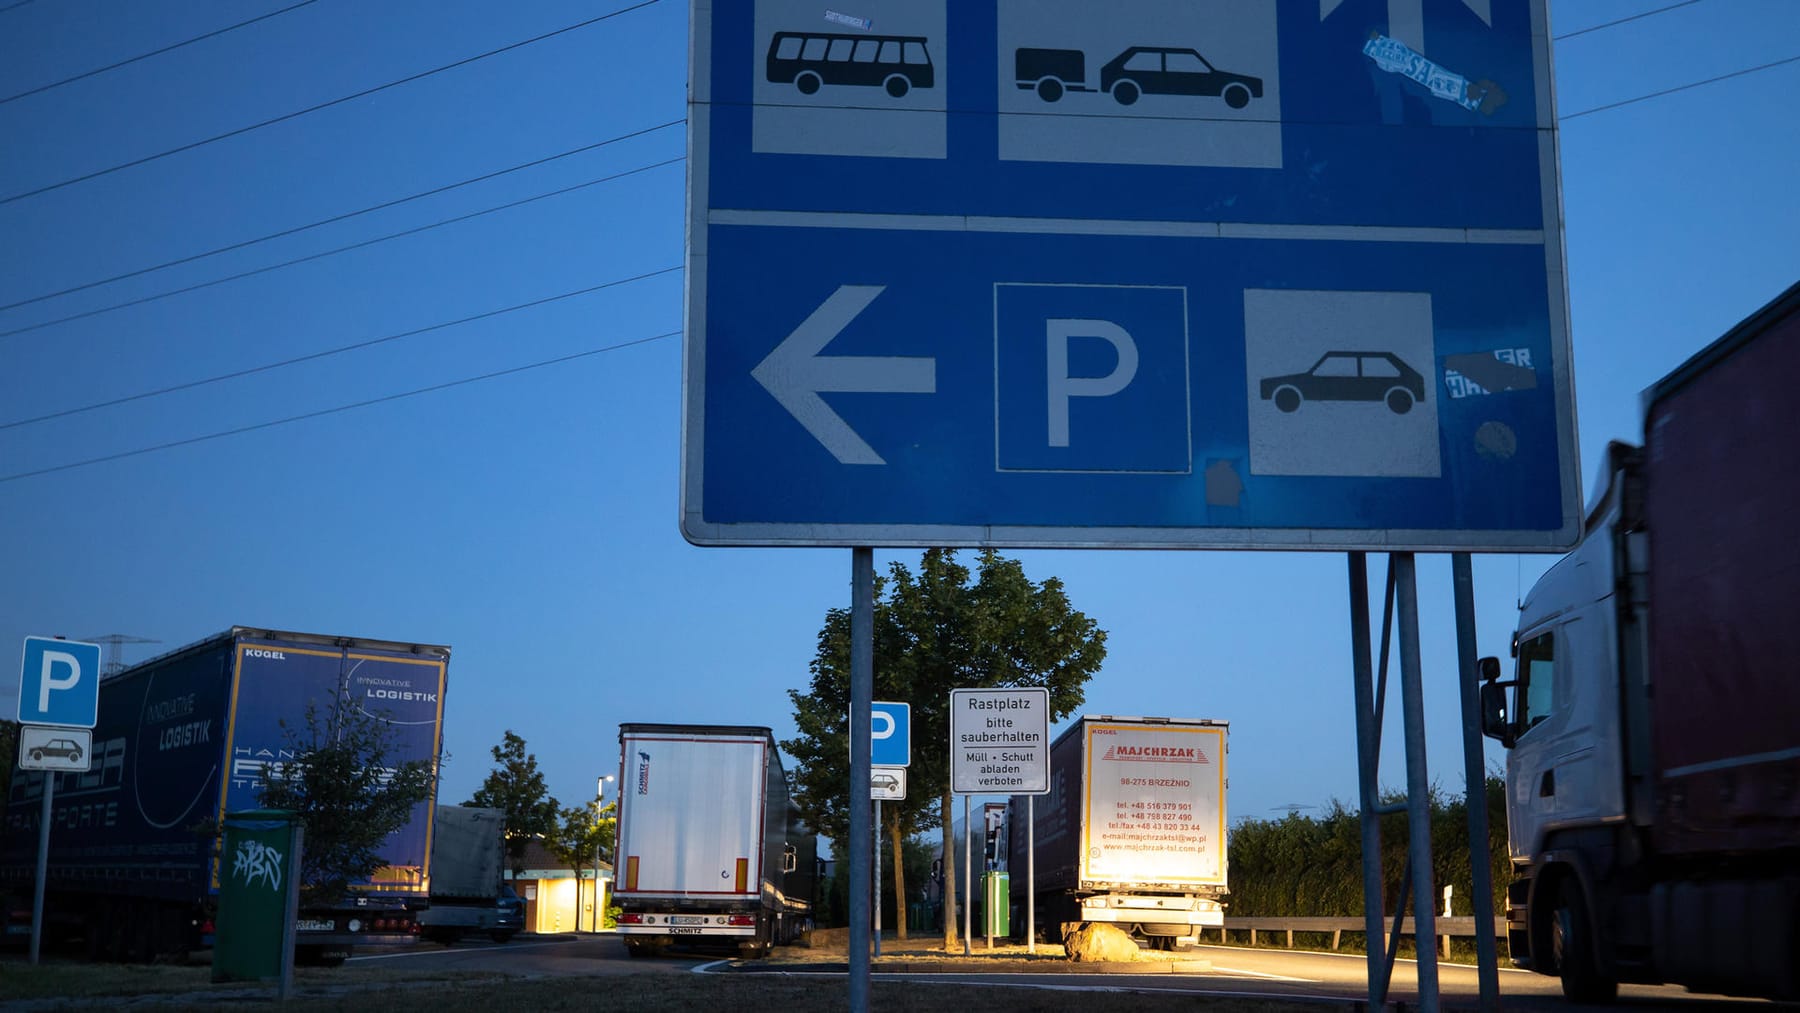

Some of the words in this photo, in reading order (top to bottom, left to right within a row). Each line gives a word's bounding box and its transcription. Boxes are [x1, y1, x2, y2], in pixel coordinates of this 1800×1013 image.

[1046, 318, 1139, 449] P
[37, 650, 82, 712] P
[367, 688, 438, 703] LOGISTIK
[968, 698, 1031, 711] Rastplatz
[986, 717, 1013, 728] bitte
[159, 719, 212, 752] LOGISTIK
[960, 731, 1040, 743] sauberhalten
[1117, 746, 1195, 757] MAJCHRZAK
[966, 752, 988, 763] Müll
[1001, 752, 1034, 763] Schutt
[980, 764, 1020, 774] abladen
[978, 776, 1023, 786] verboten
[1120, 777, 1147, 786] 98-275
[1178, 803, 1192, 811] 901
[4, 801, 119, 831] TRANPORTE
[1152, 823, 1161, 831] 43
